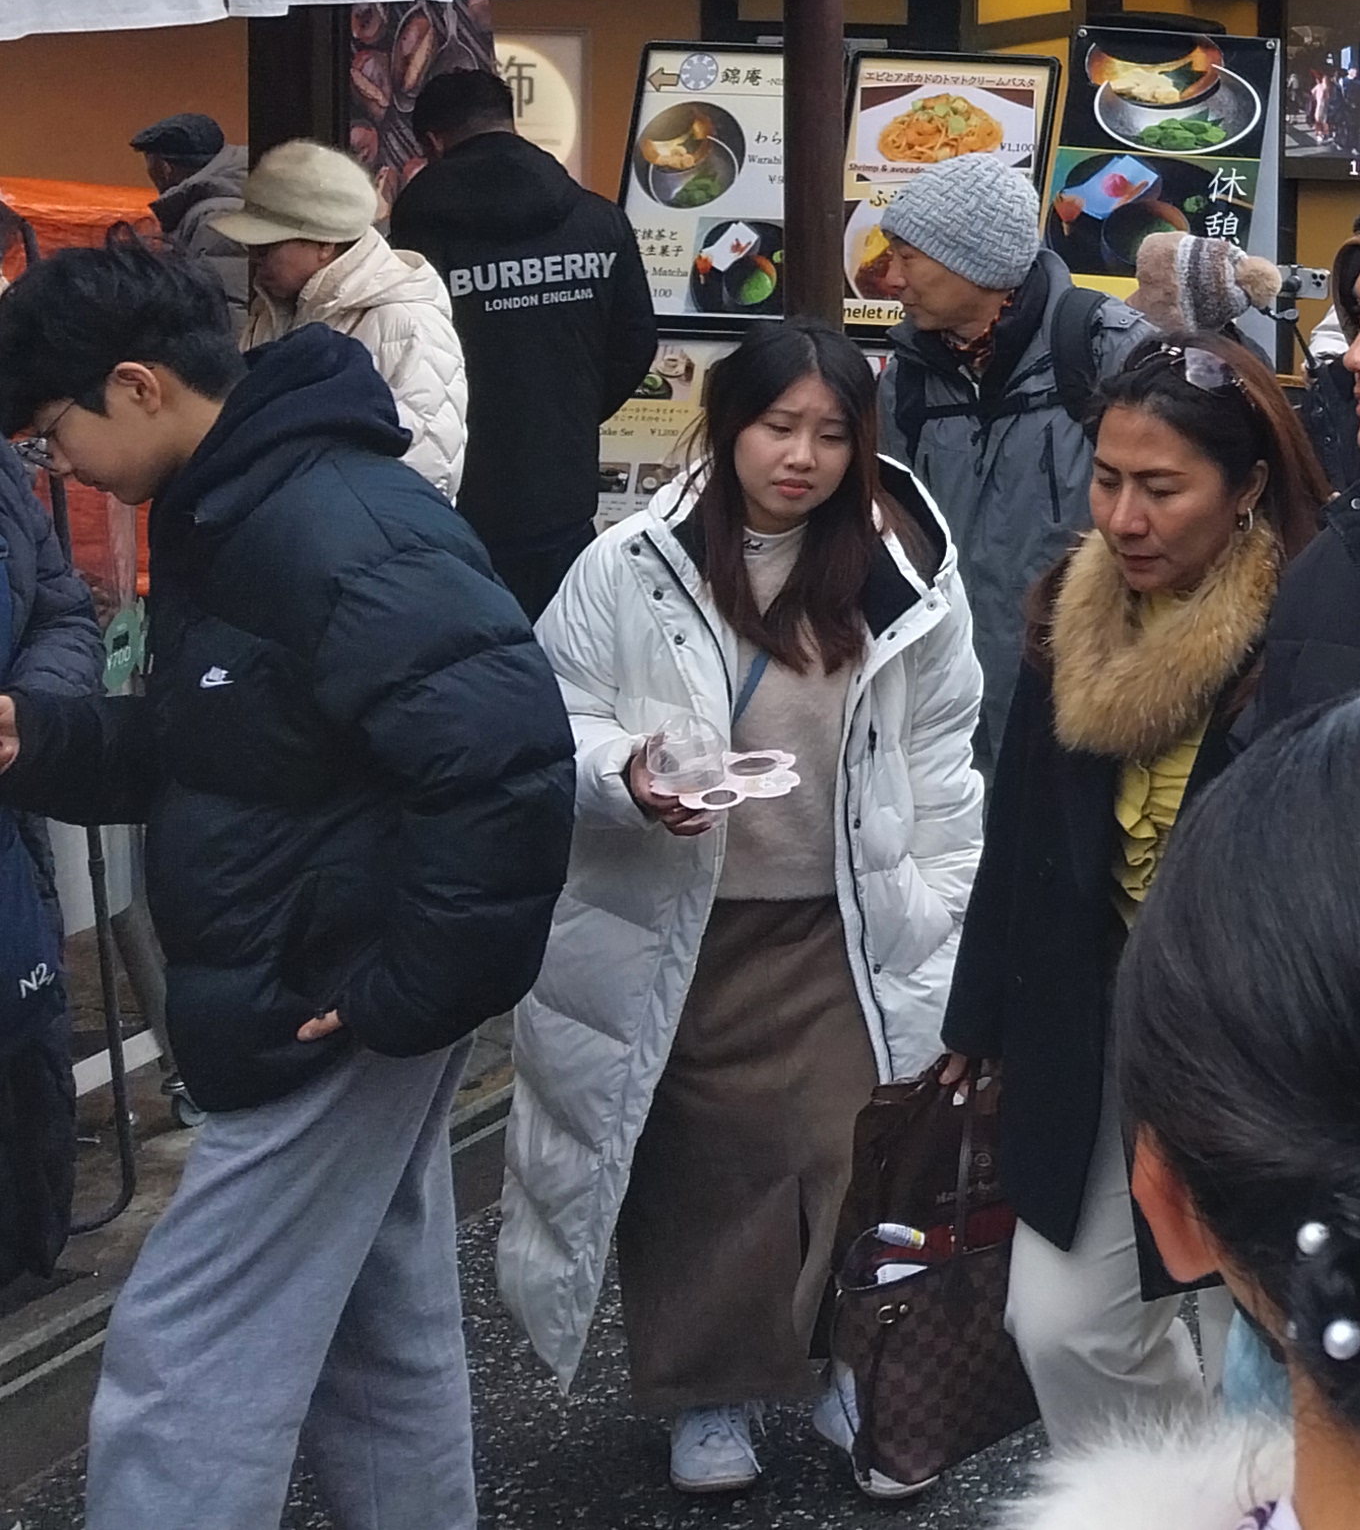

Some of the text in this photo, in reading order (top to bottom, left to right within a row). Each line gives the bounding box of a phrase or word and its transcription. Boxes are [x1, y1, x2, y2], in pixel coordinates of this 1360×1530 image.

[719, 67, 763, 86] 錦庵
[864, 72, 1036, 88] エビとアボカドのトマトクリームパスタ
[999, 141, 1034, 153] ¥1,100
[849, 163, 879, 175] Shrimp
[881, 164, 888, 173] &
[450, 252, 617, 297] BURBERRY
[651, 267, 689, 277] Matcha
[485, 294, 539, 312] LONDON
